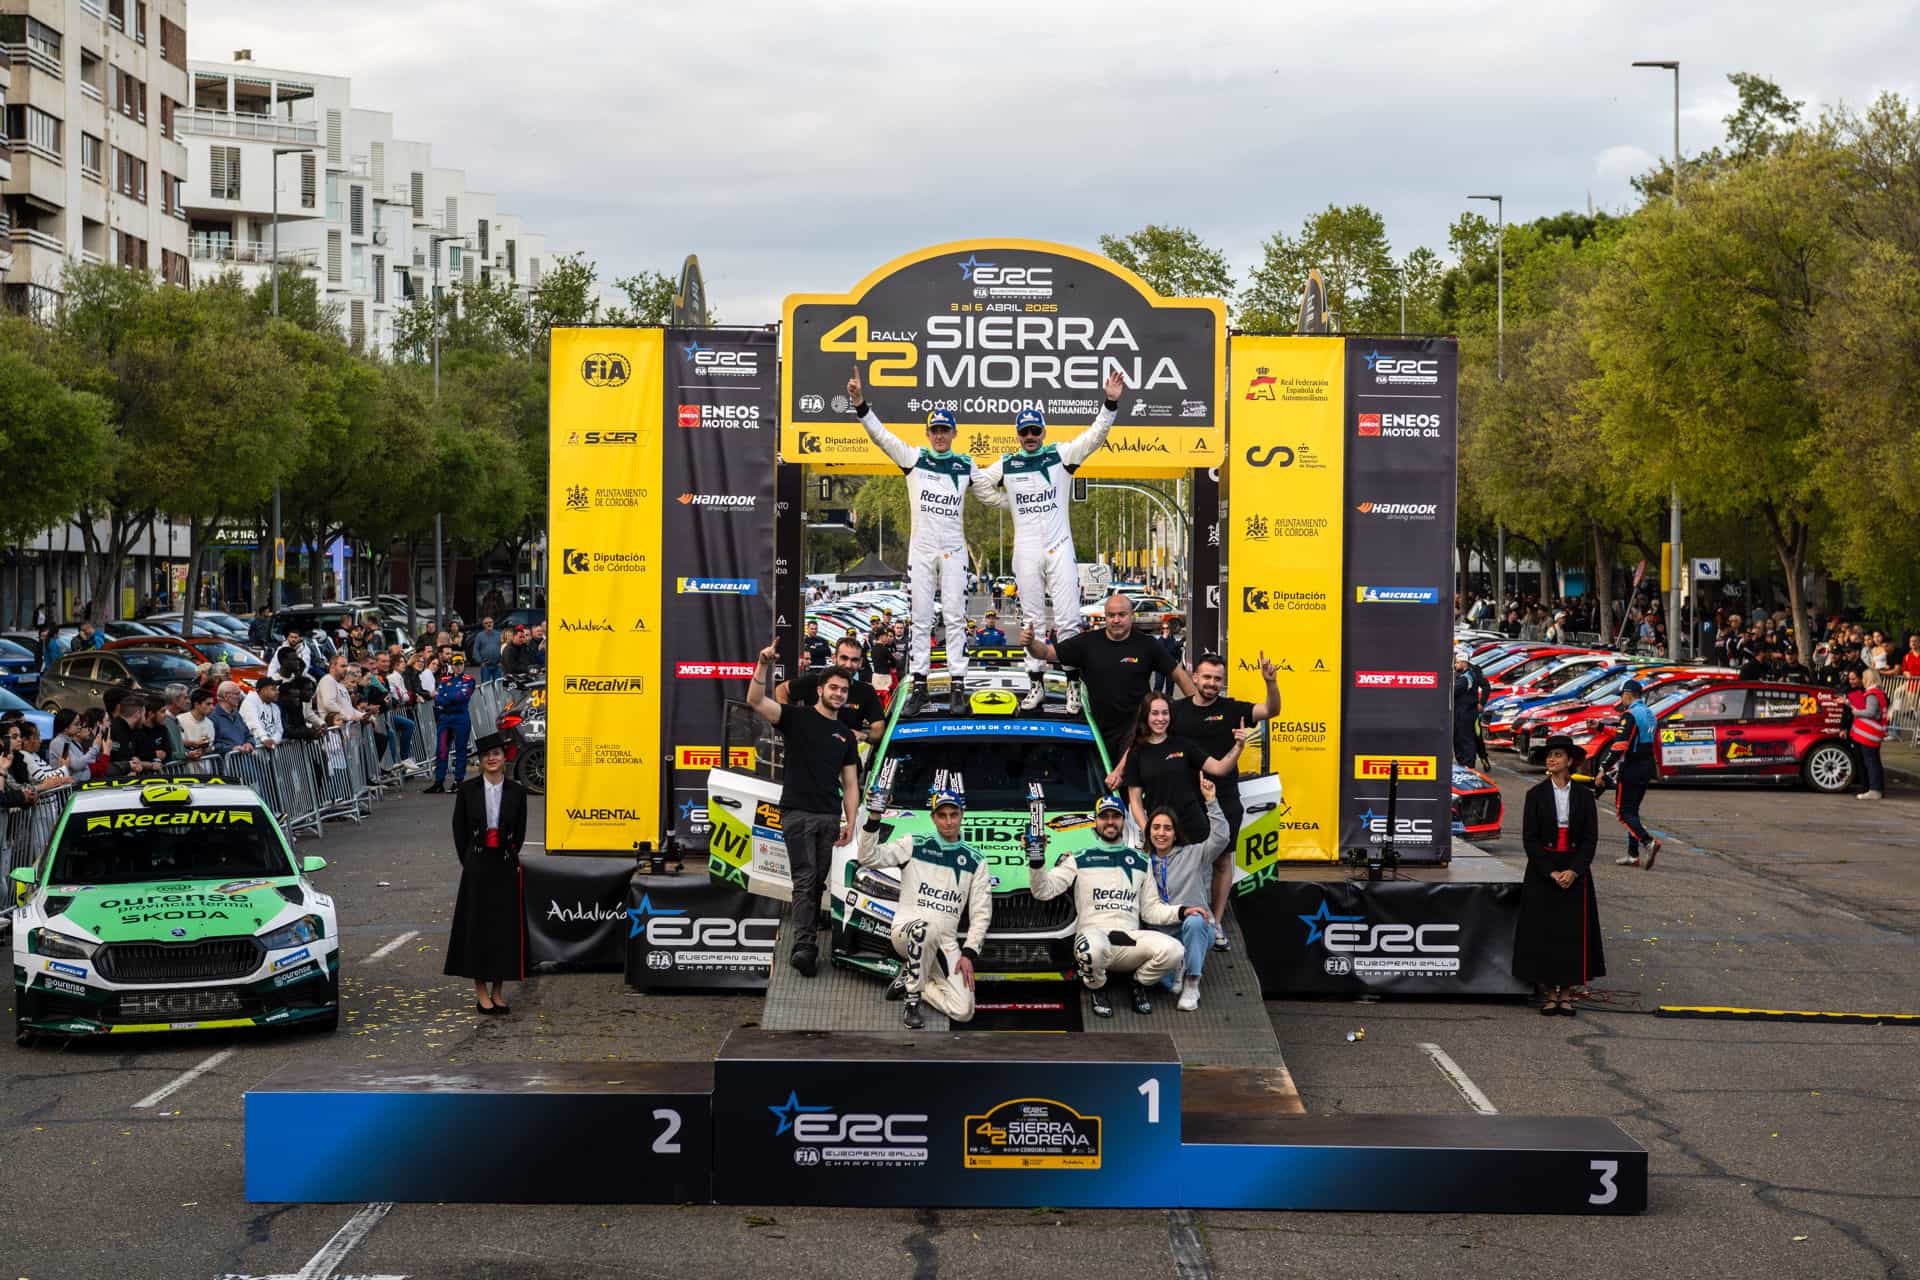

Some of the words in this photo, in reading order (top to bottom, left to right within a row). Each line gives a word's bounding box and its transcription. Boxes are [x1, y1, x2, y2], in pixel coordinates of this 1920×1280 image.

[973, 267, 1053, 285] ERC
[975, 304, 983, 312] 6
[986, 304, 1022, 312] ABRIL
[1025, 304, 1058, 312] 2025
[871, 331, 917, 341] RALLY
[926, 316, 1140, 351] SIERRA
[695, 351, 757, 365] ERC
[583, 359, 628, 381] FIA
[926, 354, 1188, 390] MORENA
[1375, 360, 1438, 374] ERC
[799, 397, 823, 410] FIA
[963, 396, 1044, 414] CÓRDOBA
[702, 405, 760, 419] ENEOS
[702, 419, 739, 428] MOTOR
[742, 420, 760, 429] OIL
[1382, 414, 1440, 427] ENEOS
[1382, 428, 1419, 437] MOTOR
[1423, 428, 1440, 437] OIL
[825, 436, 868, 446] Diputación
[1101, 436, 1170, 454] Andalucía
[835, 445, 869, 453] Córdoba
[595, 488, 647, 497] AYUNTAMIENTO
[920, 489, 962, 506] Recalvi
[1016, 486, 1057, 505] Recalvi
[595, 498, 605, 506] DE
[607, 497, 639, 507] CÓRDOBA
[1274, 518, 1328, 527] AYUNTAMIENTO
[1274, 528, 1284, 537] DE
[1285, 526, 1319, 537] CÓRDOBA
[593, 552, 645, 563] Diputación
[593, 564, 605, 572] de
[607, 563, 646, 572] Córdoba
[1273, 590, 1326, 602] Diputación
[1273, 602, 1285, 610] de
[1287, 601, 1327, 610] Córdoba
[678, 666, 715, 674] MRF
[717, 666, 754, 676] TYRES
[579, 678, 629, 692] Recalvi
[1357, 675, 1395, 684] MRF
[1397, 675, 1434, 685] TYRES
[1800, 696, 1817, 714] 23
[1271, 721, 1327, 733] PEGASUS
[1271, 734, 1294, 743] AERO
[1296, 734, 1326, 743] GROUP
[114, 810, 225, 829] Recalvi
[566, 808, 640, 820] VALRENTAL
[100, 894, 249, 909] ourense
[1092, 888, 1137, 902] Recalvi
[118, 902, 195, 914] provincia
[200, 900, 253, 909] termal
[646, 917, 781, 947] ERC
[1324, 923, 1460, 953] ERC
[647, 953, 671, 969] FIA
[1325, 960, 1350, 973] FIA
[1419, 960, 1458, 968] RALLY
[282, 964, 312, 980] ourense
[53, 979, 86, 993] ourense
[1138, 1078, 1160, 1124] 1
[1022, 1106, 1049, 1114] ERC
[651, 1108, 682, 1154] 2
[793, 1113, 928, 1142] ERC
[976, 1122, 1007, 1145] 42
[1008, 1122, 1074, 1133] SIERRA
[1008, 1133, 1090, 1145] MORENA
[794, 1150, 818, 1163] FIA
[1588, 1160, 1619, 1205] 3
